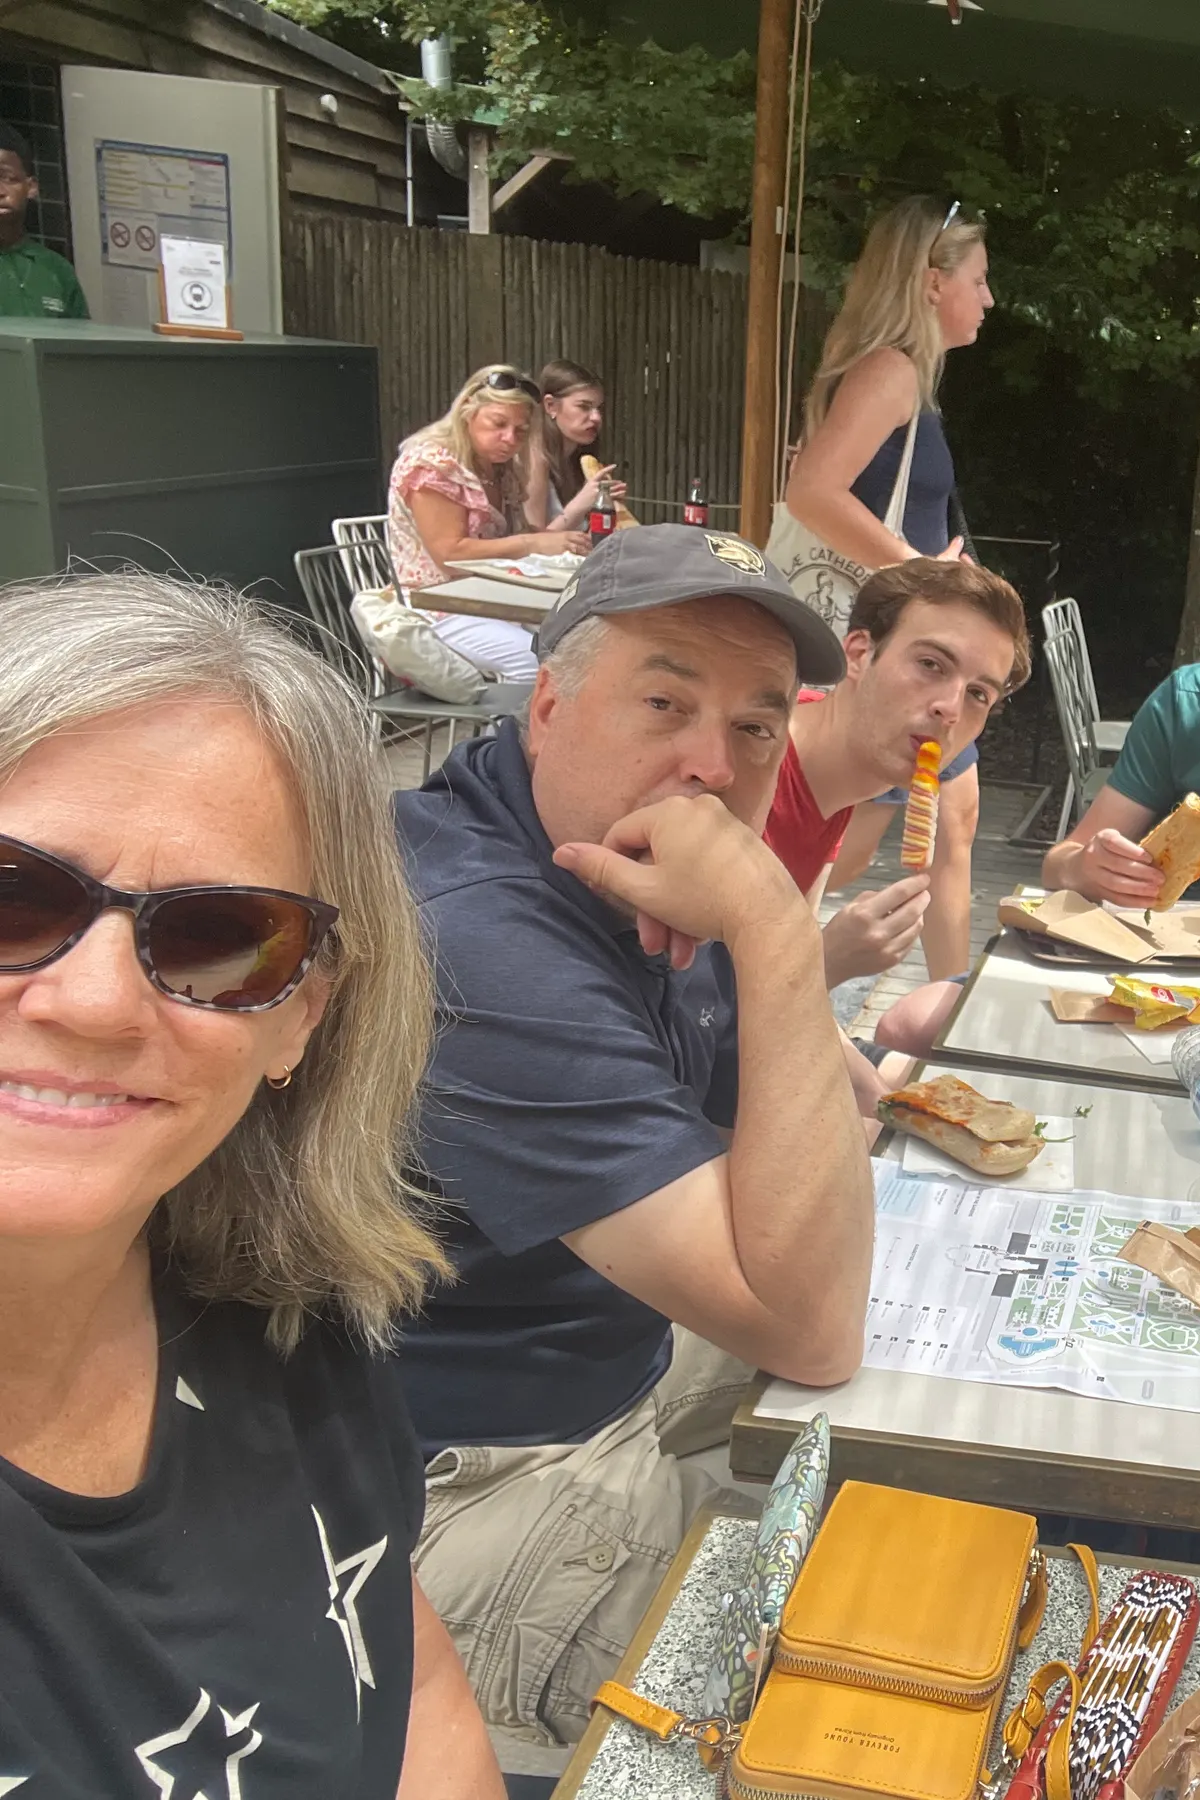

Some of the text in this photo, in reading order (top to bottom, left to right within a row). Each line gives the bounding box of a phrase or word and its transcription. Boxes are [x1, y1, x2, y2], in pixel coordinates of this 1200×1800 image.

[834, 1727, 852, 1735] Korea
[824, 1732, 901, 1754] FOREVER YOUNG
[867, 1732, 895, 1743] Originally
